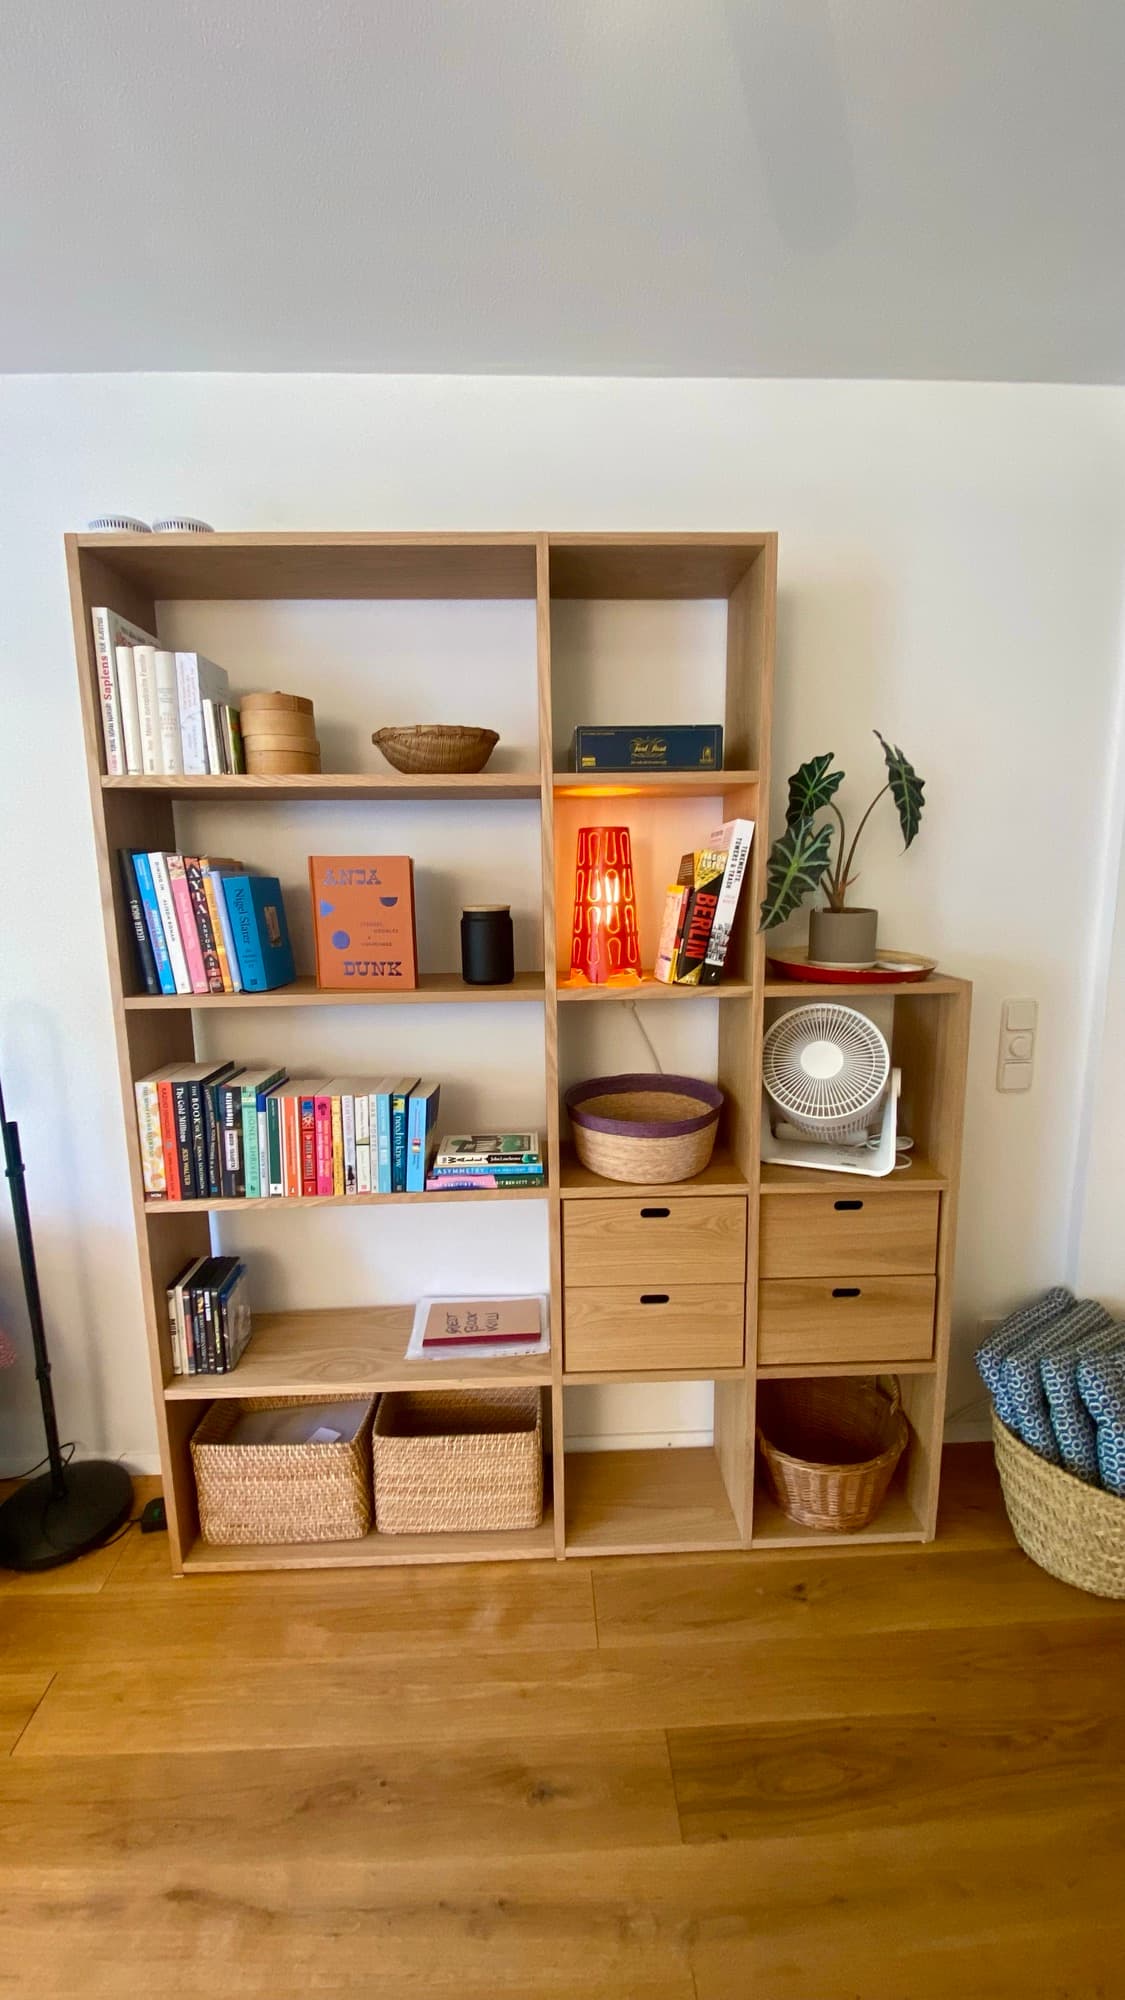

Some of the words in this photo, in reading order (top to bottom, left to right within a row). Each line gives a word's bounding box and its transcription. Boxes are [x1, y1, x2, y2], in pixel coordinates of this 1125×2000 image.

[101, 656, 112, 700] Sapiens
[732, 837, 742, 861] TOWERS
[735, 845, 748, 883] TENEMENTS,
[324, 869, 381, 885] ANJA
[726, 871, 735, 889] TRASH
[233, 888, 246, 915] Nigel
[241, 916, 250, 945] Slater
[685, 892, 718, 959] BERLIN
[135, 920, 145, 941] LECKER
[343, 961, 402, 976] DUNK
[176, 1087, 184, 1099] The
[177, 1101, 185, 1114] Cold
[192, 1097, 200, 1123] BOOK
[179, 1116, 187, 1142] Millions
[248, 1110, 256, 1141] LIONEL
[395, 1116, 404, 1134] need
[395, 1136, 402, 1144] to
[395, 1146, 404, 1168] know
[437, 1167, 485, 1175] ASYMMETRY
